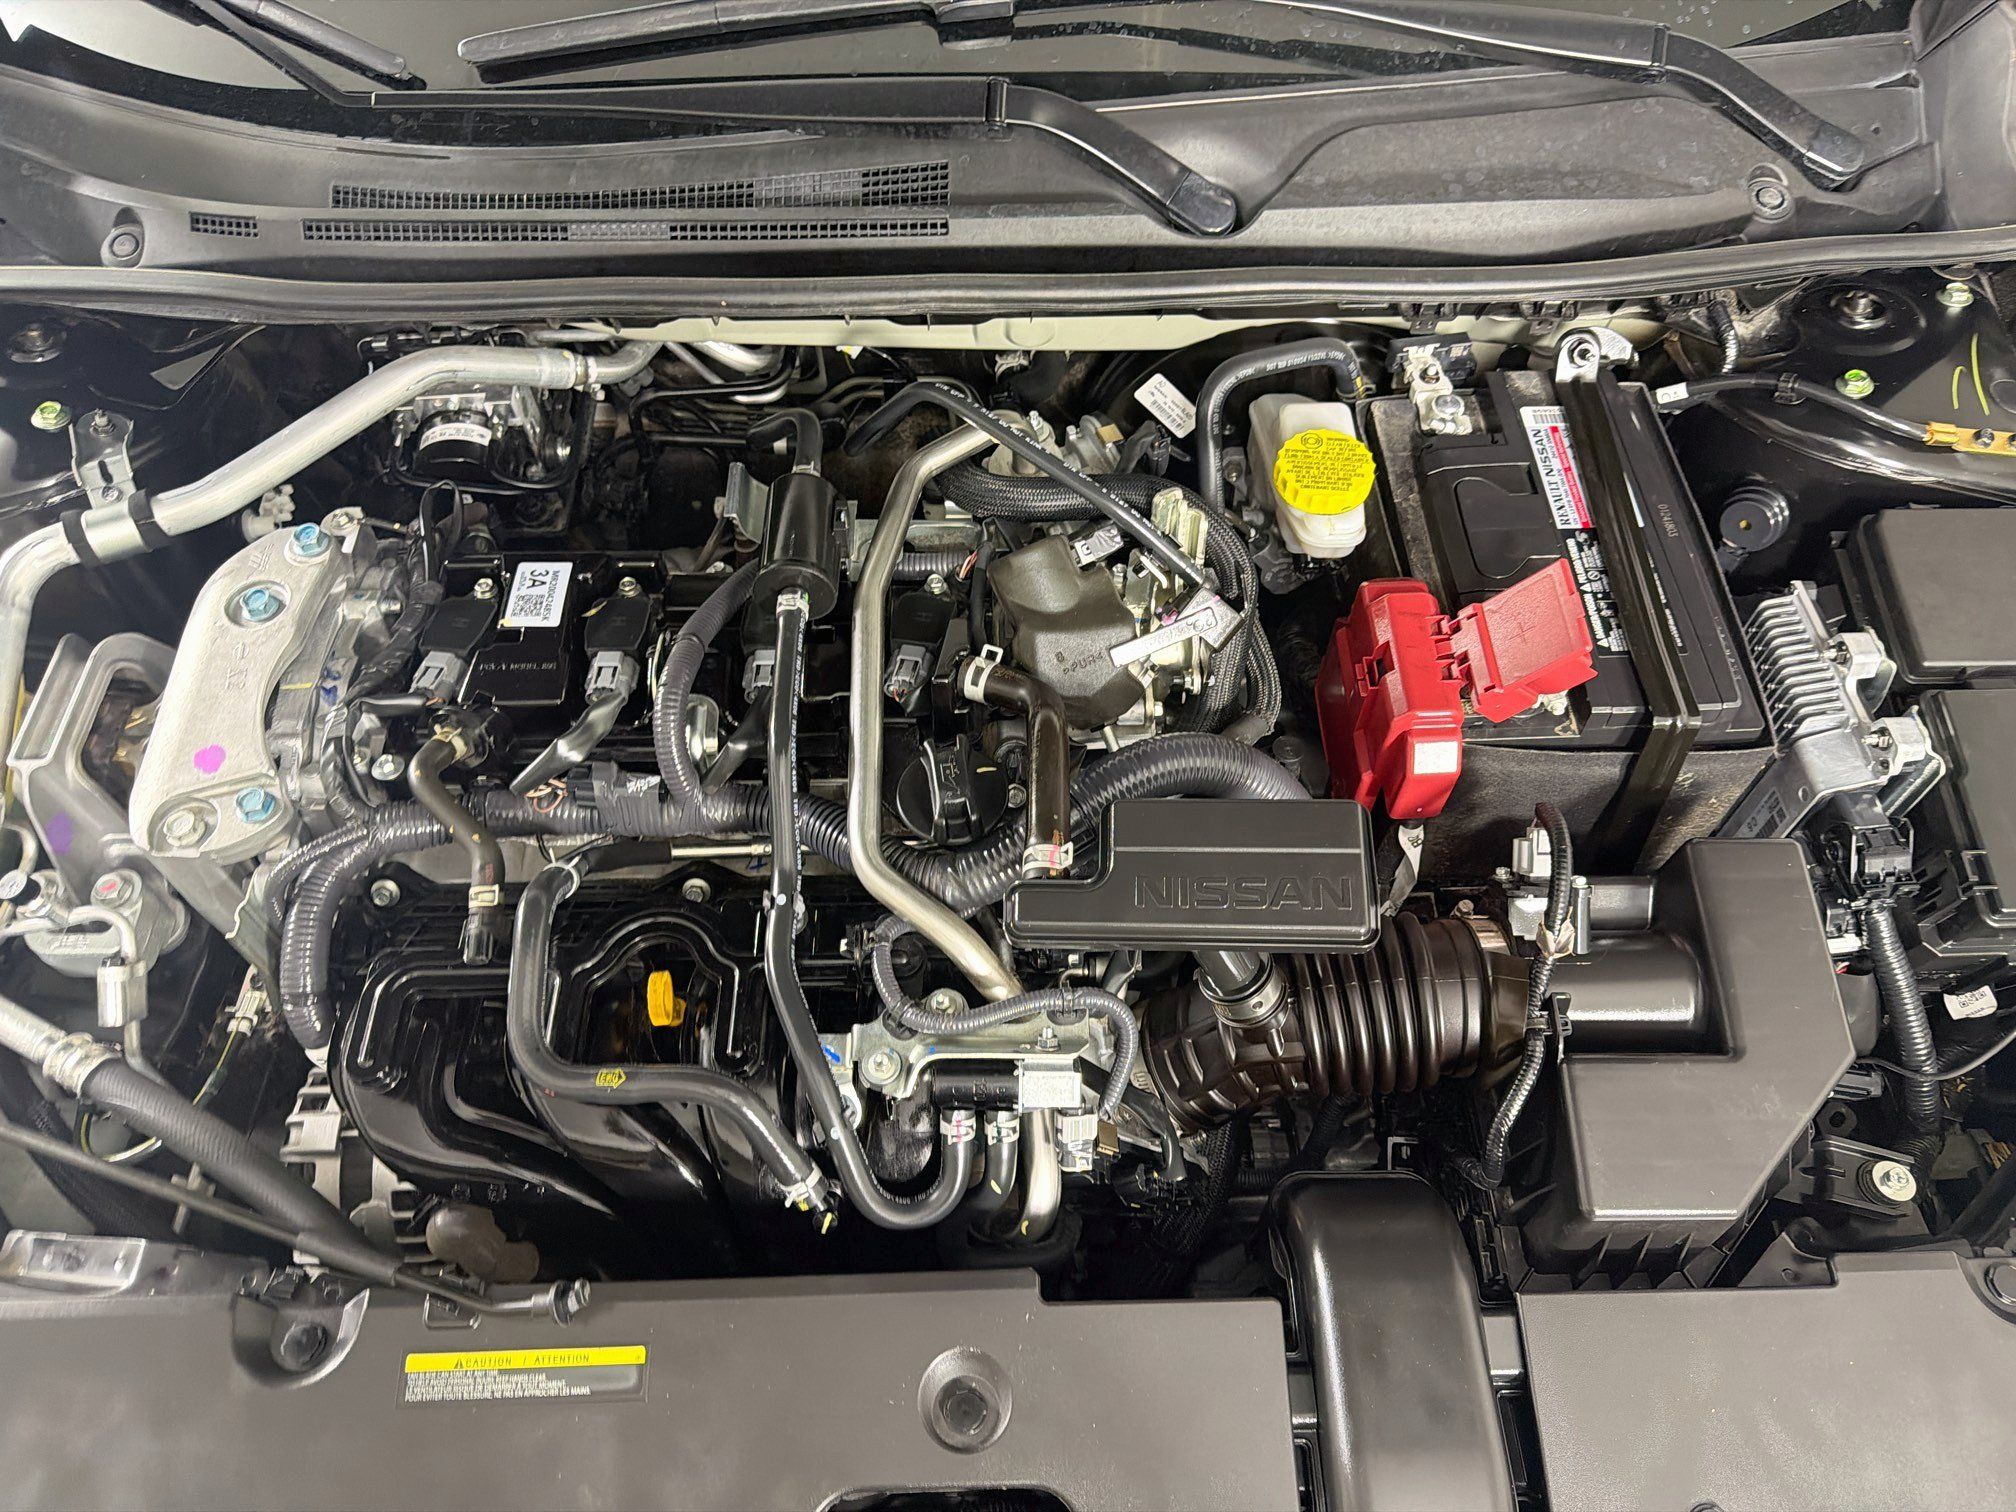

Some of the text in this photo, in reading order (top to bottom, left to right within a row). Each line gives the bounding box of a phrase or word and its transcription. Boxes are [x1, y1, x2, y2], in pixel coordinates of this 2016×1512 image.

[1531, 429, 1556, 477] NISSAN
[1548, 480, 1571, 526] RENAULT
[527, 569, 549, 589] 3A
[1135, 875, 1353, 911] NISSAN
[465, 1357, 512, 1368] CAUTION
[534, 1354, 590, 1365] ATTENTION
